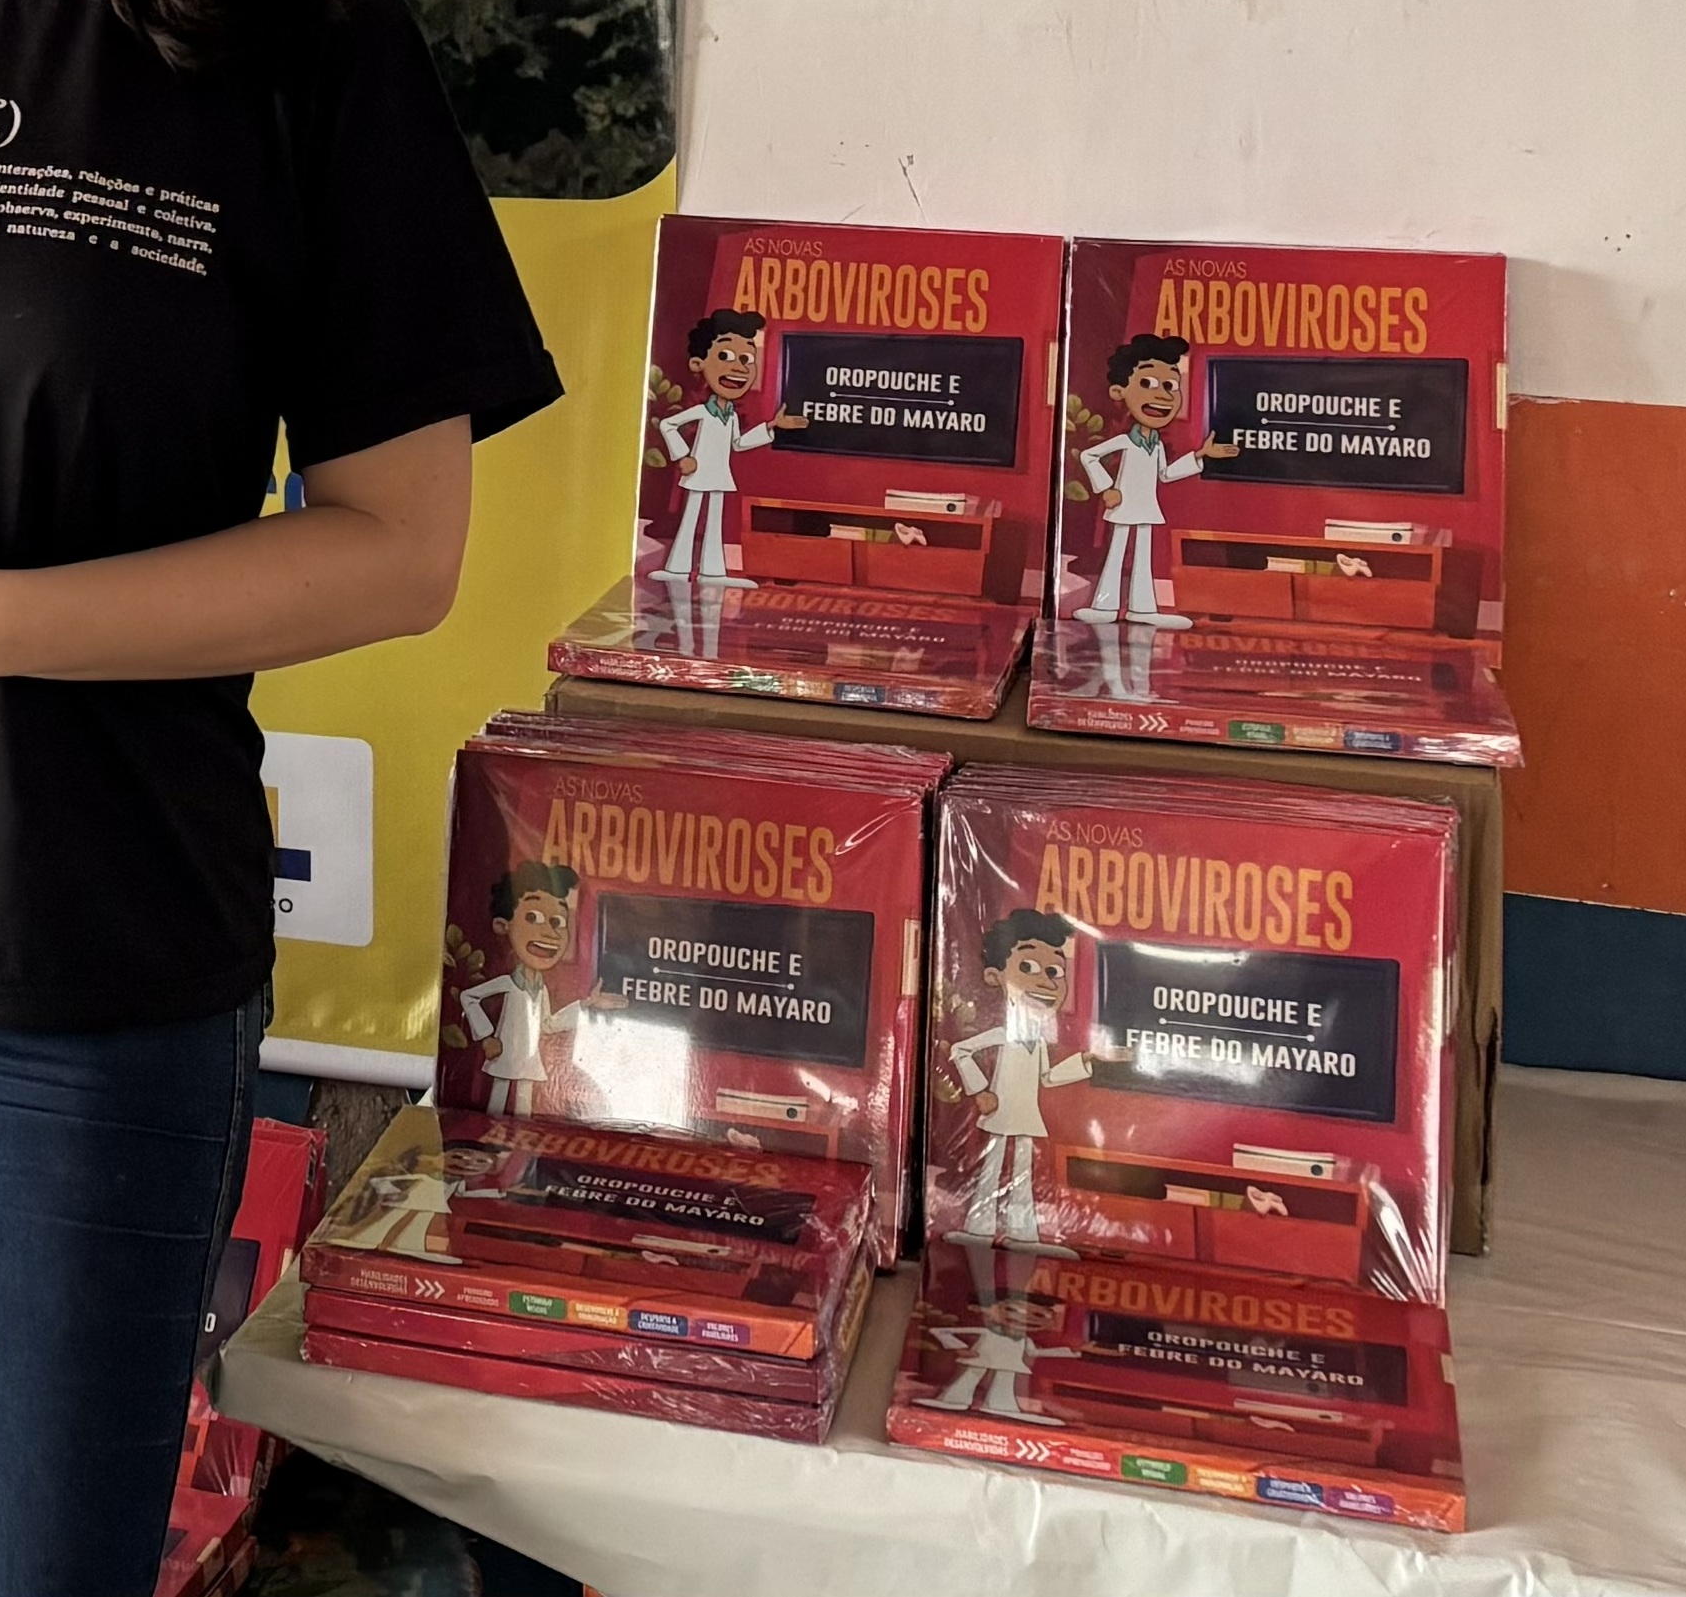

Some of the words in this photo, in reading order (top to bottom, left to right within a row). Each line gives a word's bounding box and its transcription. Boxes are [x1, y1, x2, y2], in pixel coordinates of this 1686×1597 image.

[72, 190, 129, 211] pessoal
[137, 205, 147, 215] e
[154, 210, 216, 233] coletiva,
[78, 170, 140, 194] relações
[145, 186, 155, 196] e
[160, 189, 220, 214] práticas
[6, 223, 76, 241] natureza
[88, 234, 98, 244] e
[110, 239, 119, 250] a
[131, 245, 207, 276] sociedade,
[167, 234, 213, 254] narra,
[743, 237, 766, 255] AS
[767, 239, 823, 257] NOVAS
[1163, 259, 1185, 276] AS
[1189, 260, 1247, 279] NOVAS
[732, 255, 990, 334] ARBOVIROSES
[1154, 278, 1428, 354] ARBOVIROSES
[826, 366, 943, 393] OROPOUCHE
[949, 375, 962, 394] E
[802, 401, 864, 425] FEBRE
[870, 405, 897, 427] DO
[903, 408, 986, 433] MAYARO
[1256, 392, 1381, 418] OROPOUCHE
[1388, 398, 1401, 419] E
[1232, 429, 1298, 452] FEBRE
[1305, 432, 1333, 453] DO
[1340, 436, 1430, 459] MAYARO
[553, 776, 577, 796] AS
[580, 779, 643, 804] NOVAS
[541, 798, 835, 904] ARBOVIROSES
[1046, 821, 1072, 841] AS
[1077, 825, 1144, 848] NOVAS
[1035, 843, 1354, 952] ARBOVIROSES
[648, 936, 780, 974] OROPOUCHE
[789, 954, 802, 976] E
[622, 976, 691, 1007] FEBRE
[699, 986, 728, 1012] DO
[737, 990, 831, 1024] MAYARO
[1153, 986, 1298, 1025] OROPOUCHE
[1307, 1003, 1323, 1027] E
[1126, 1028, 1202, 1059] FEBRE
[1210, 1037, 1242, 1064] DO
[1251, 1044, 1356, 1078] MAYARO
[480, 1120, 785, 1189] ARBOVIROSES
[545, 1184, 616, 1203] FEBRE
[625, 1197, 656, 1208] DO
[664, 1202, 765, 1227] MAYARO
[577, 1174, 715, 1204] OROPOUCHE
[723, 1196, 738, 1207] E
[1025, 1267, 1356, 1339] ARBOVIROSES
[1118, 1343, 1198, 1365] FEBRE
[1209, 1357, 1242, 1369] DO
[1252, 1362, 1364, 1386] MAYARO
[1147, 1330, 1301, 1361] OROPOUCHE
[1310, 1353, 1325, 1364] E
